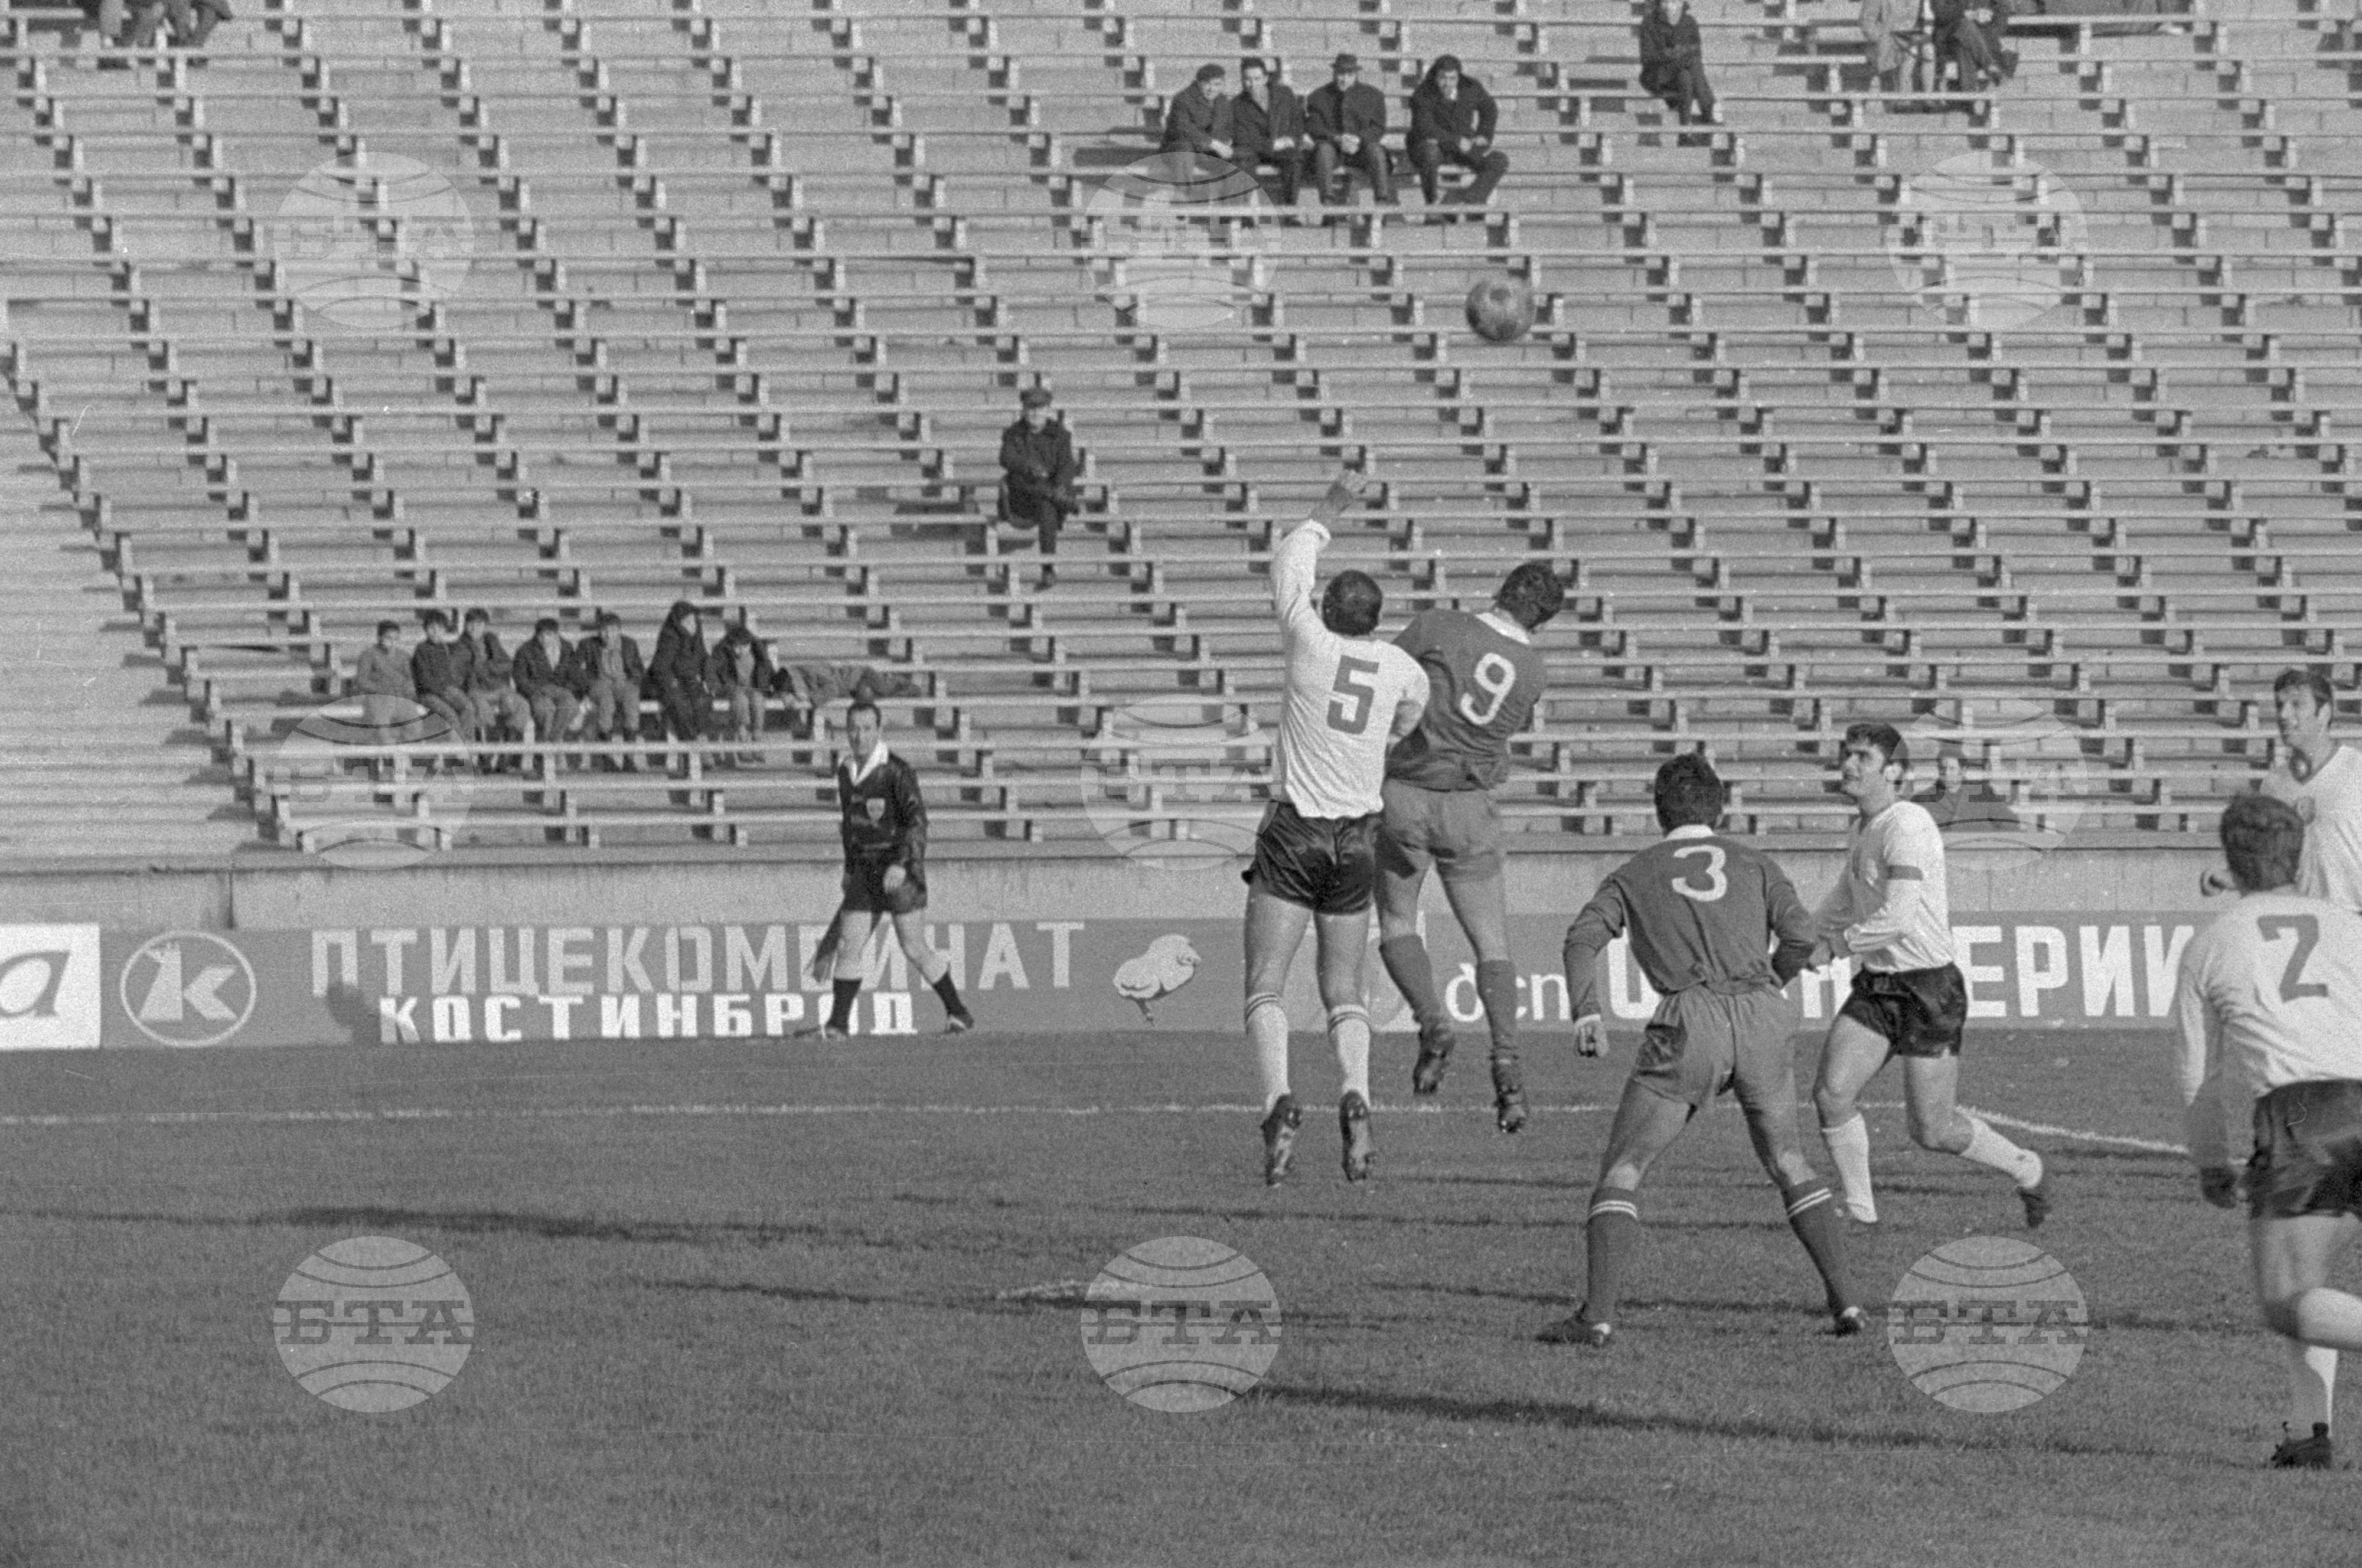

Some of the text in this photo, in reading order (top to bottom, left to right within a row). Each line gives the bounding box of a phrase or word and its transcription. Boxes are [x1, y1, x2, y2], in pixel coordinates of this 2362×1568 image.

[1327, 655, 1380, 734] 5
[1460, 653, 1516, 725] 9
[1672, 845, 1727, 901] 3
[2257, 914, 2329, 1002] 2
